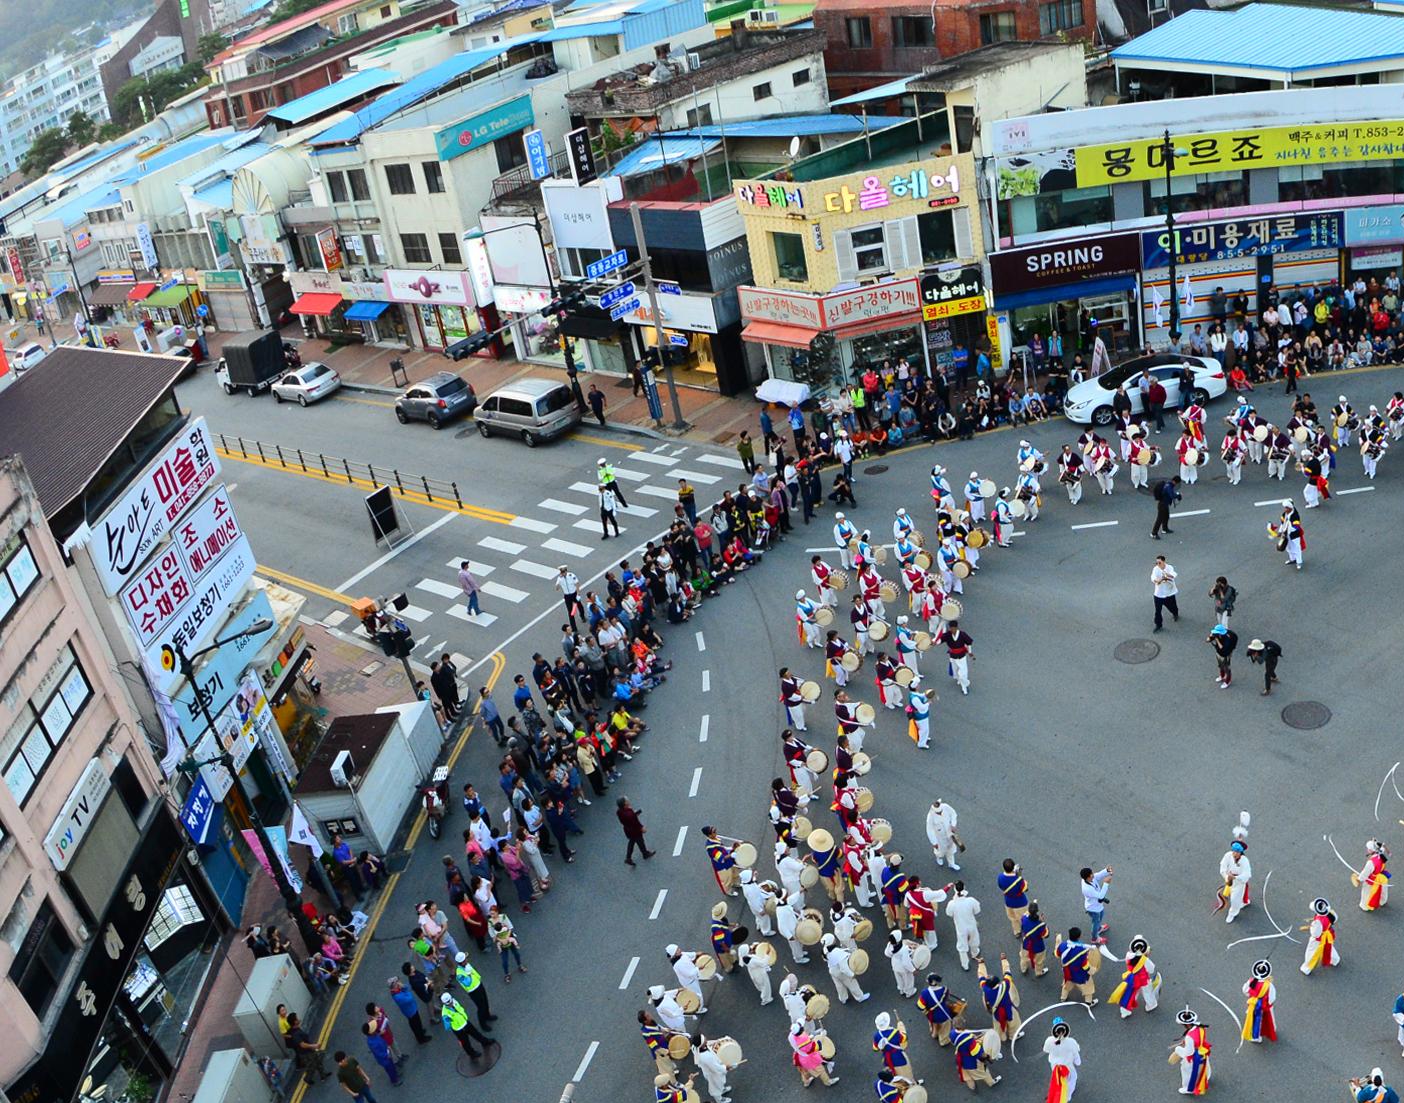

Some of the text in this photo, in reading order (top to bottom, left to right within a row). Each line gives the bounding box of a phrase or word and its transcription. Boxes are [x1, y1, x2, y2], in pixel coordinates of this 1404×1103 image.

[474, 126, 488, 138] LG
[738, 184, 804, 209] 다올헤어
[824, 164, 961, 214] 다올헤어
[1026, 245, 1104, 273] SPRING
[189, 427, 211, 468] 학원
[152, 447, 197, 505] 미술
[212, 496, 229, 521] 소
[180, 521, 199, 550] 조
[128, 550, 181, 612] 디자인
[139, 575, 190, 635] 수채화
[55, 794, 91, 861] joy TV
